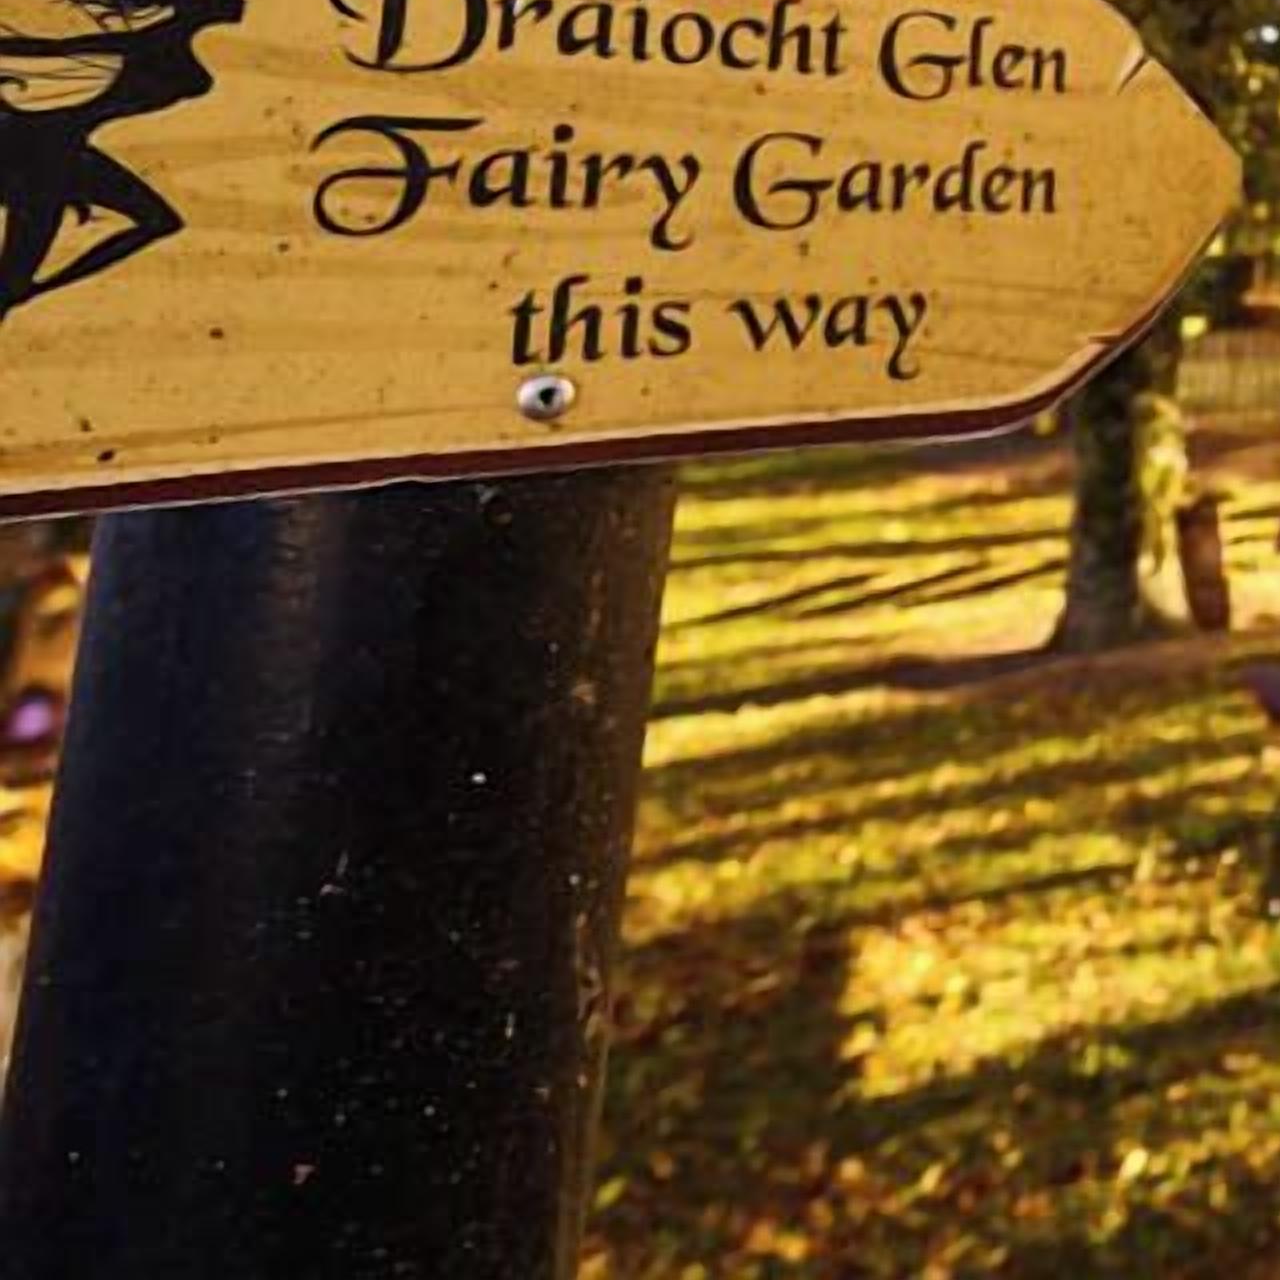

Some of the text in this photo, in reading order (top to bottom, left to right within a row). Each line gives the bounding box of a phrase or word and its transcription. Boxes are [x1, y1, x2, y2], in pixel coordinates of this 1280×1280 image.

[878, 11, 1067, 100] Glen
[310, 115, 1057, 251] Fairy Garden
[508, 274, 928, 381] this way
